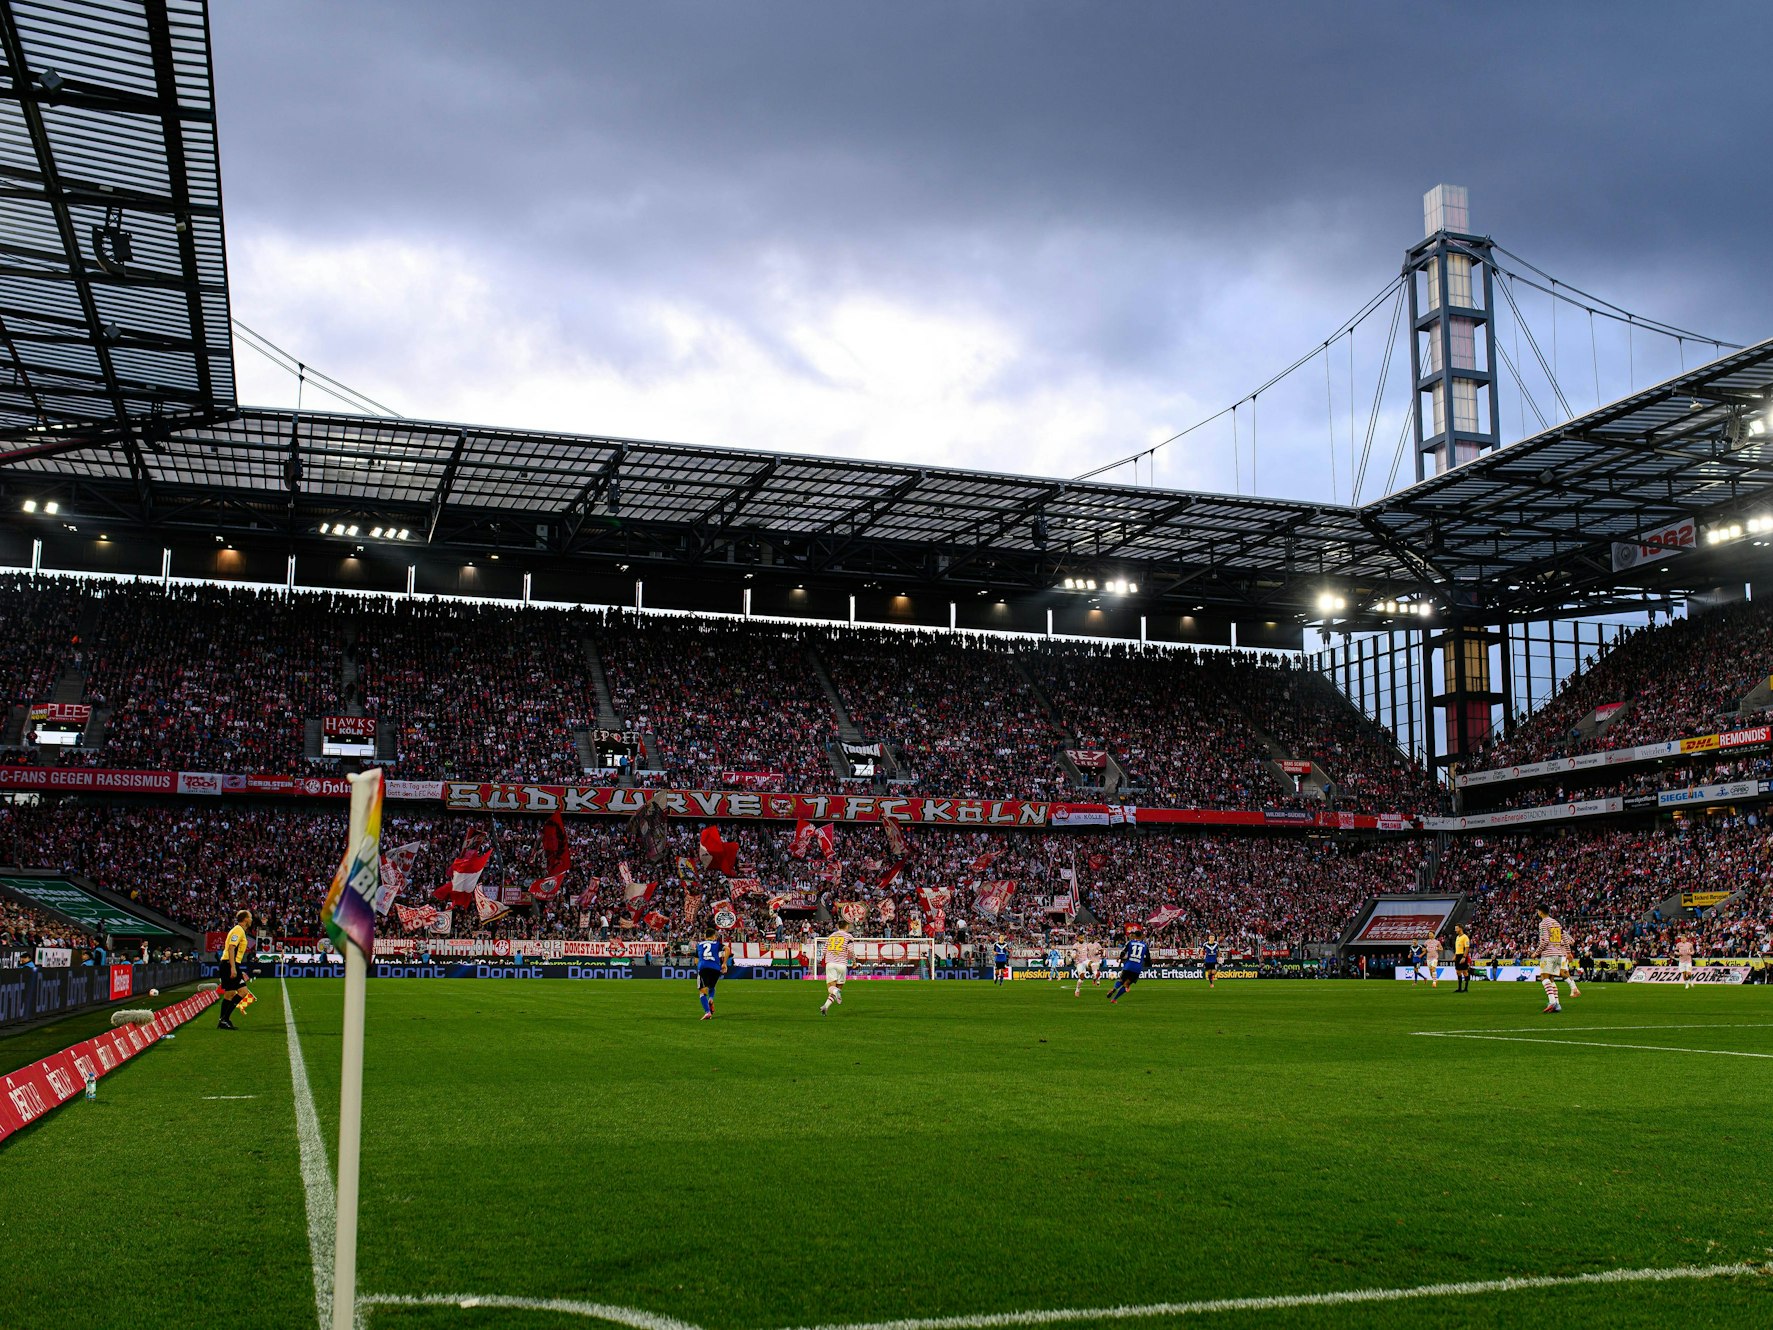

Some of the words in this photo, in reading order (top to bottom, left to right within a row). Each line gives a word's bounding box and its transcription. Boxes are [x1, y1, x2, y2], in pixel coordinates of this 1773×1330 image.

[325, 717, 376, 732] HAWKS
[339, 726, 363, 735] KÖLN
[1686, 738, 1713, 750] DHL
[51, 773, 93, 785] GEGEN
[96, 775, 171, 788] RASSISMUS
[448, 784, 760, 818] SÜDKURVE
[922, 800, 1047, 826] KÖLN
[564, 941, 606, 955] DOMSTADT
[628, 942, 667, 956] SYNDIKAT
[703, 943, 712, 957] 2
[827, 937, 844, 951] 32
[1131, 945, 1142, 959] 11
[274, 964, 346, 978] Dorint
[377, 965, 446, 978] Dorint
[477, 965, 543, 979] Dorint
[568, 966, 632, 979] Dorint
[1161, 969, 1204, 979] Erftstadt
[1648, 971, 1682, 982] PIZZA
